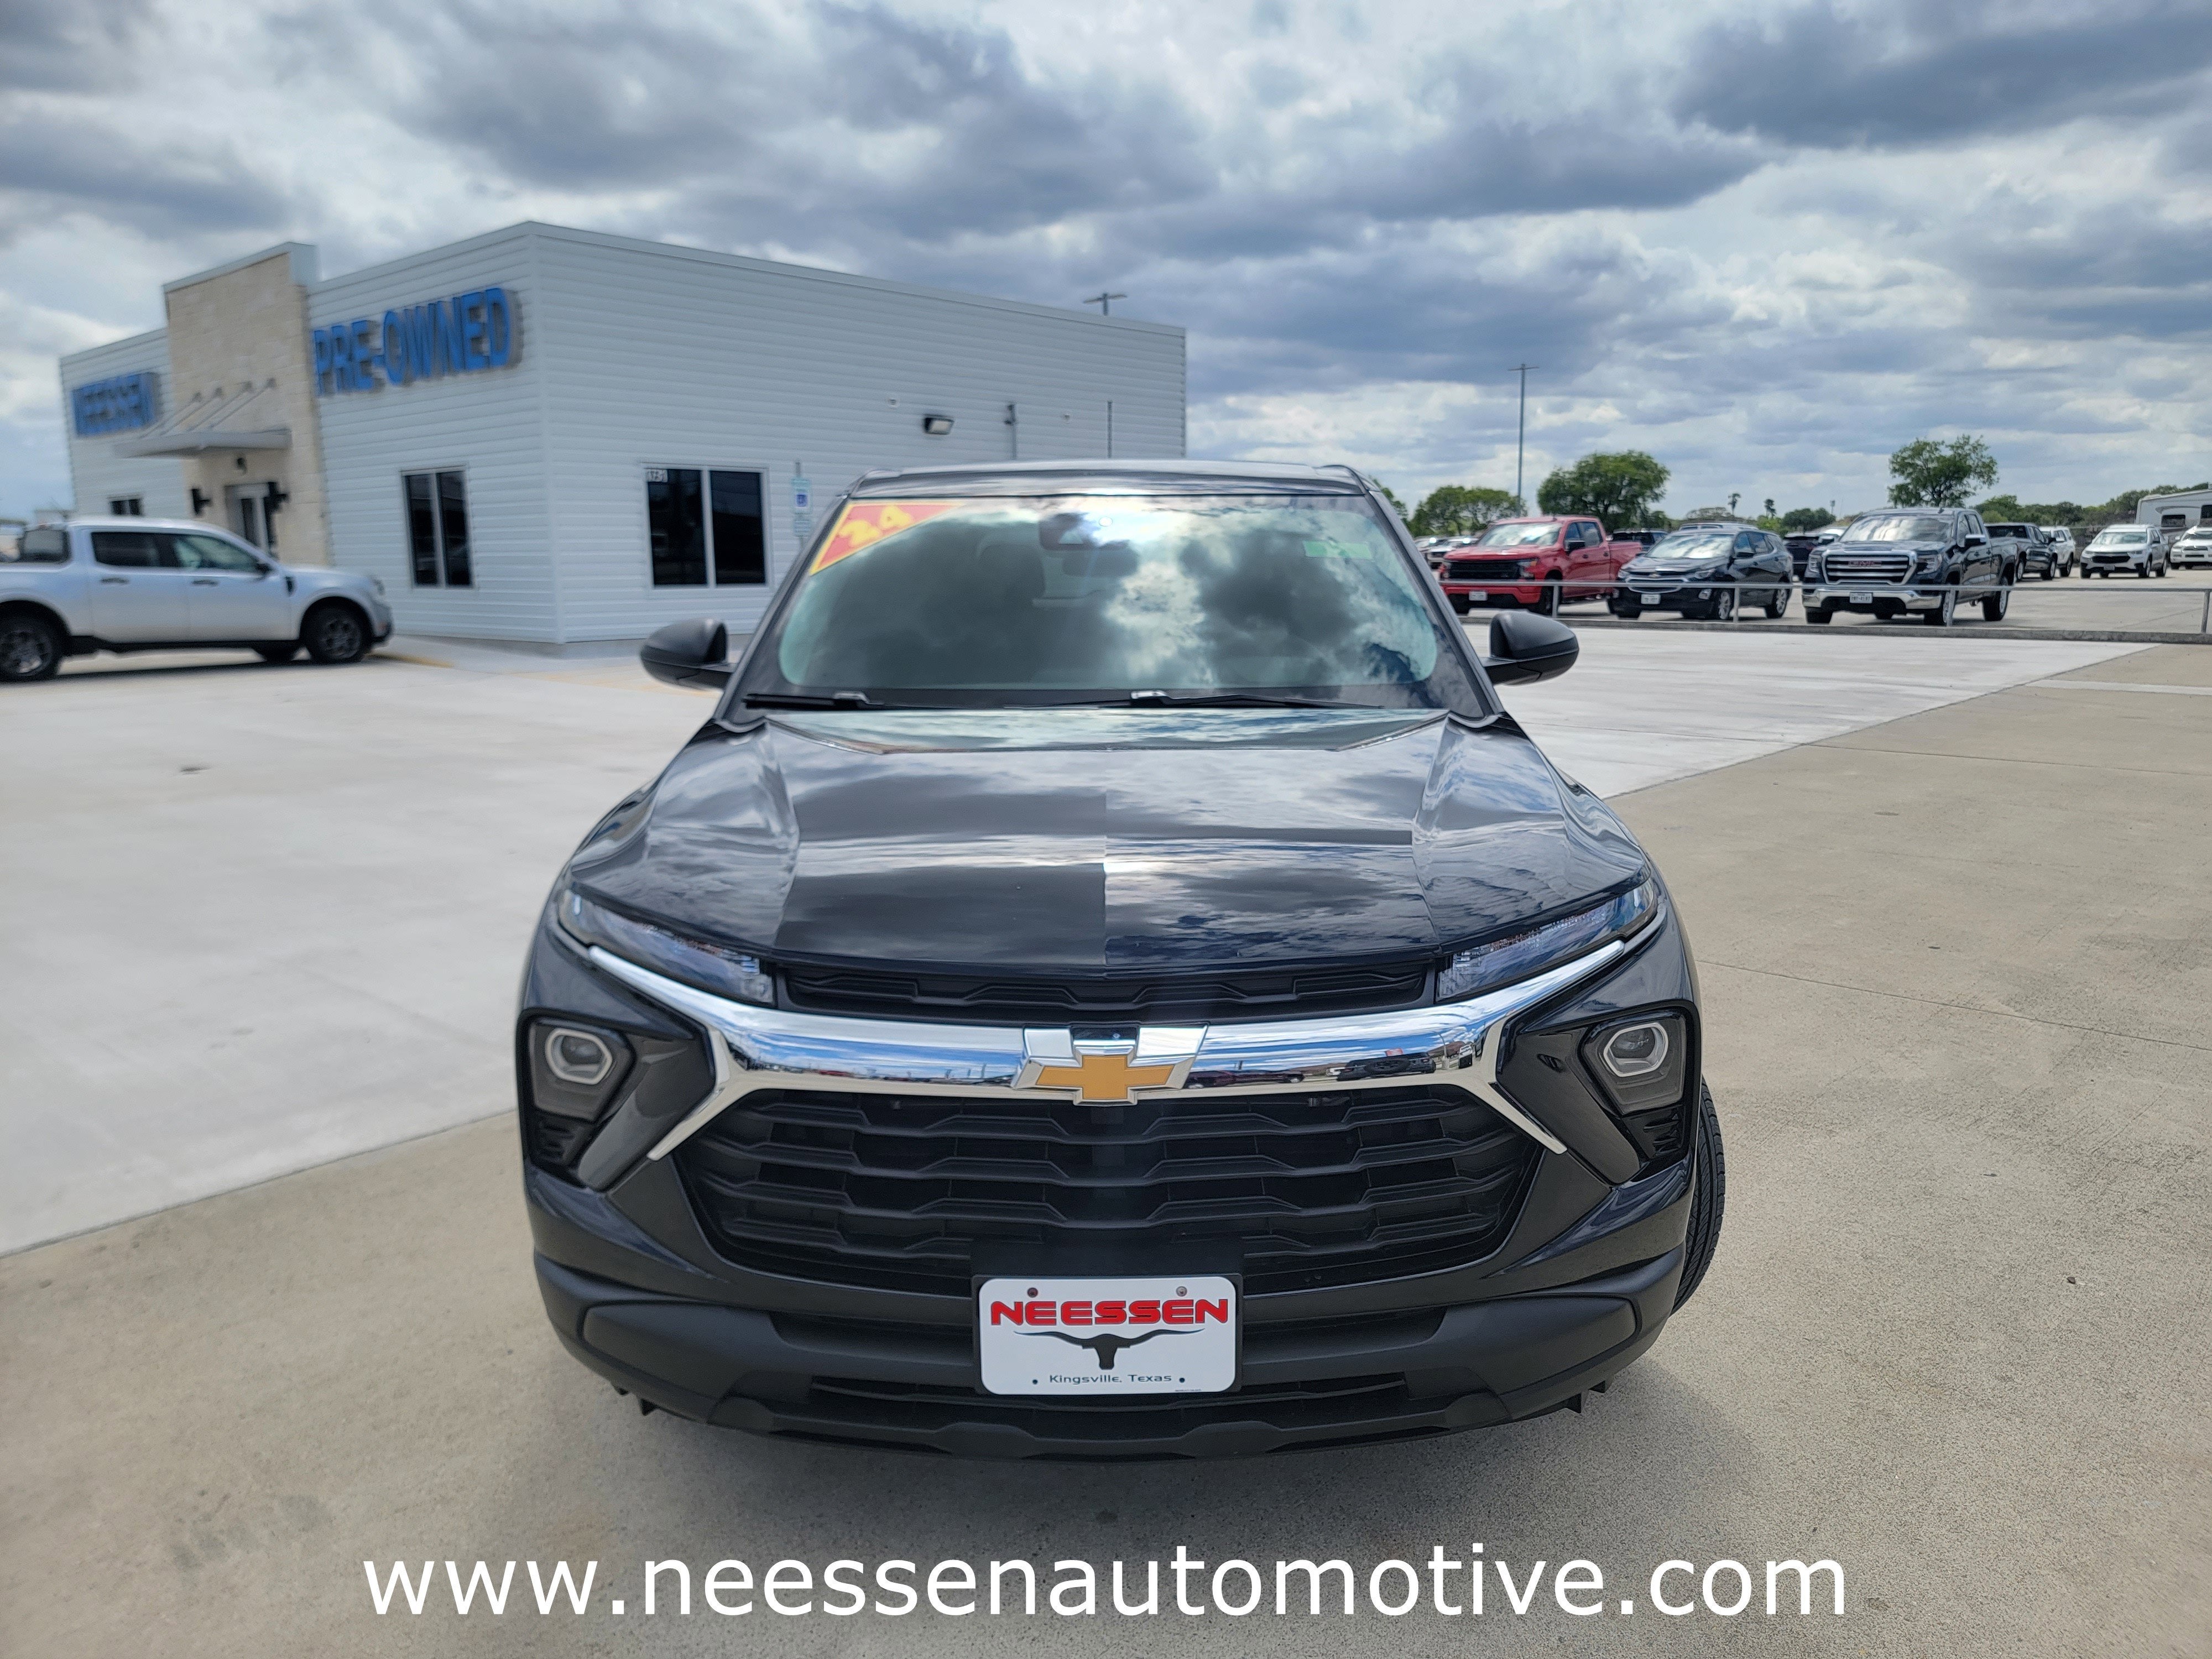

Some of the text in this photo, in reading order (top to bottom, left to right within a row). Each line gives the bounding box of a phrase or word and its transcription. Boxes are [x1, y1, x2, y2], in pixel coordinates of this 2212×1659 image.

[314, 287, 512, 397] PRE-OWNED
[838, 504, 912, 546] 24
[991, 1298, 1228, 1326] NEESSEN
[1128, 1374, 1172, 1383] Texas
